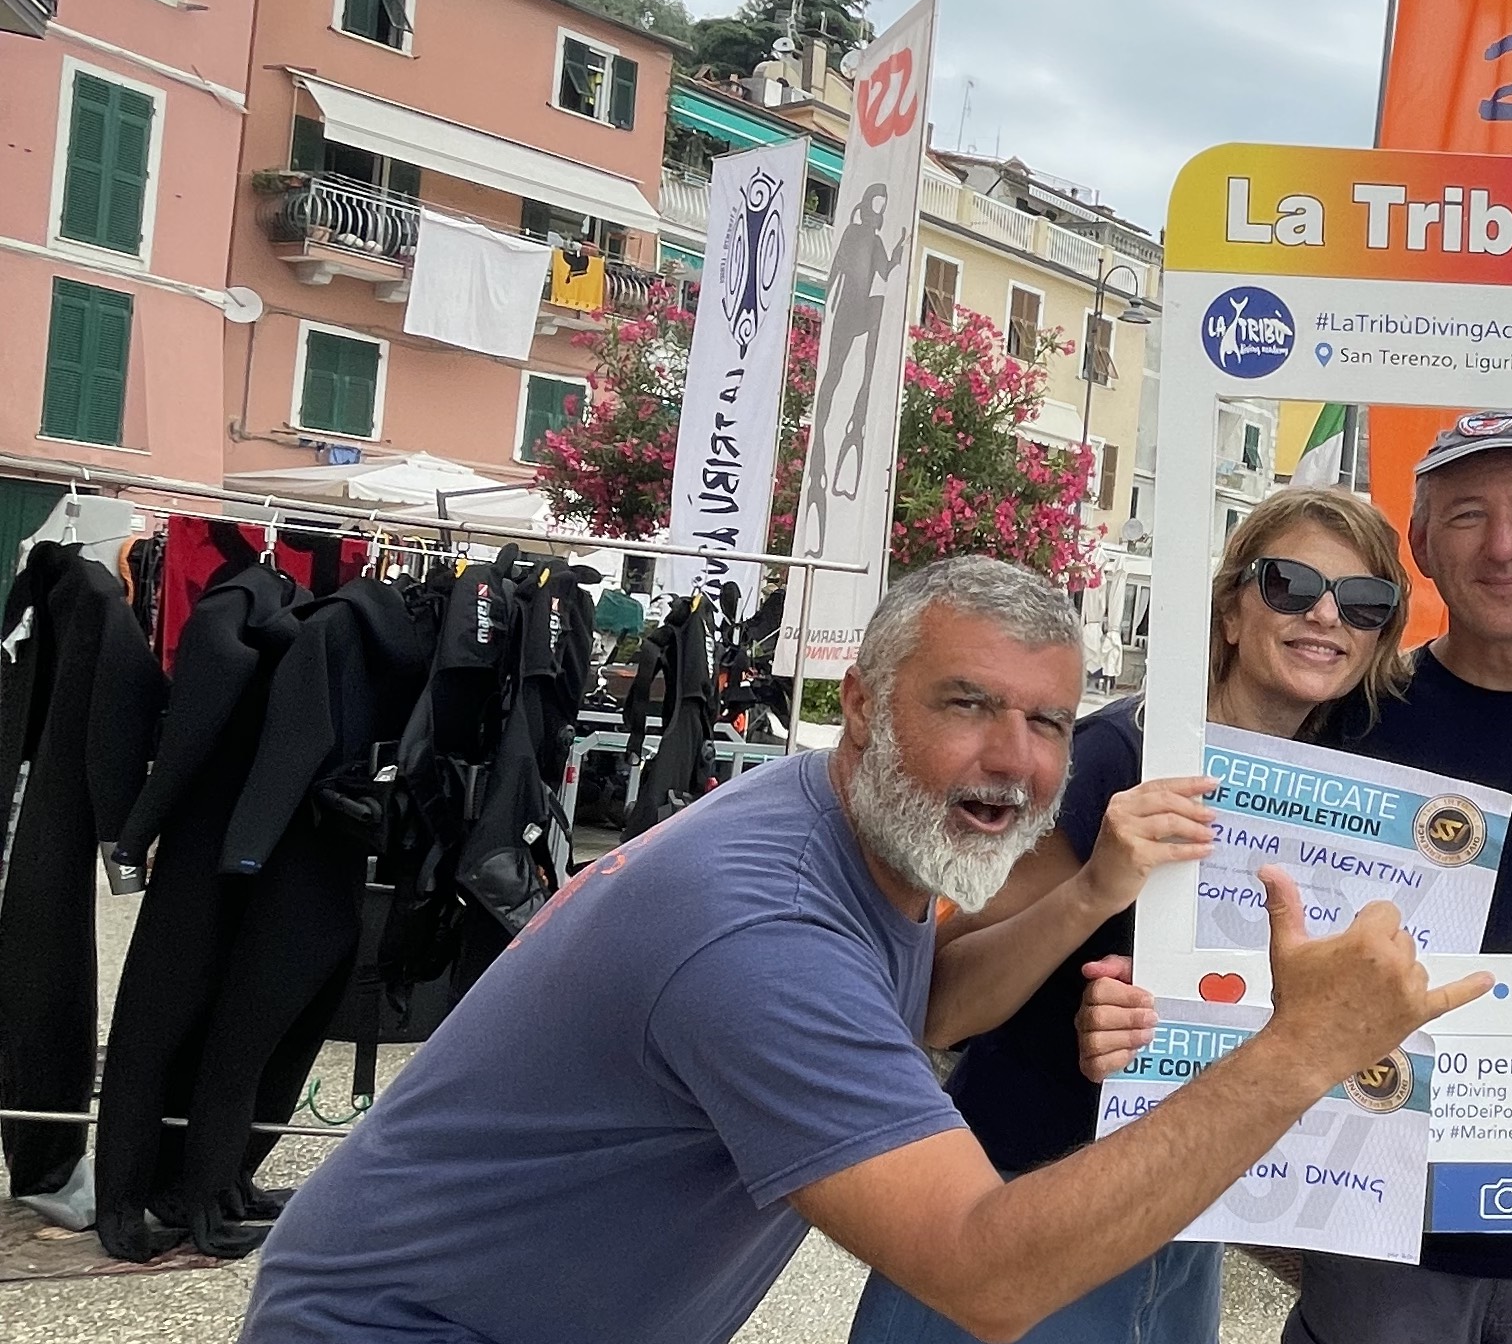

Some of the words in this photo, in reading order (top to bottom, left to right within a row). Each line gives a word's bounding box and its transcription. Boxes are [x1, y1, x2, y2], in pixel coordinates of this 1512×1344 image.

[1226, 178, 1325, 247] La
[1208, 316, 1226, 337] LA
[1237, 309, 1293, 345] TRIBÙ
[1340, 348, 1372, 364] San
[1379, 349, 1458, 370] Terenzo,
[1206, 754, 1401, 820] CERTIFICATE
[1235, 790, 1381, 837] COMPLETION
[1300, 841, 1423, 888] VALENTINI
[1446, 1083, 1507, 1100] #Diving
[1305, 1164, 1386, 1203] DIVING
